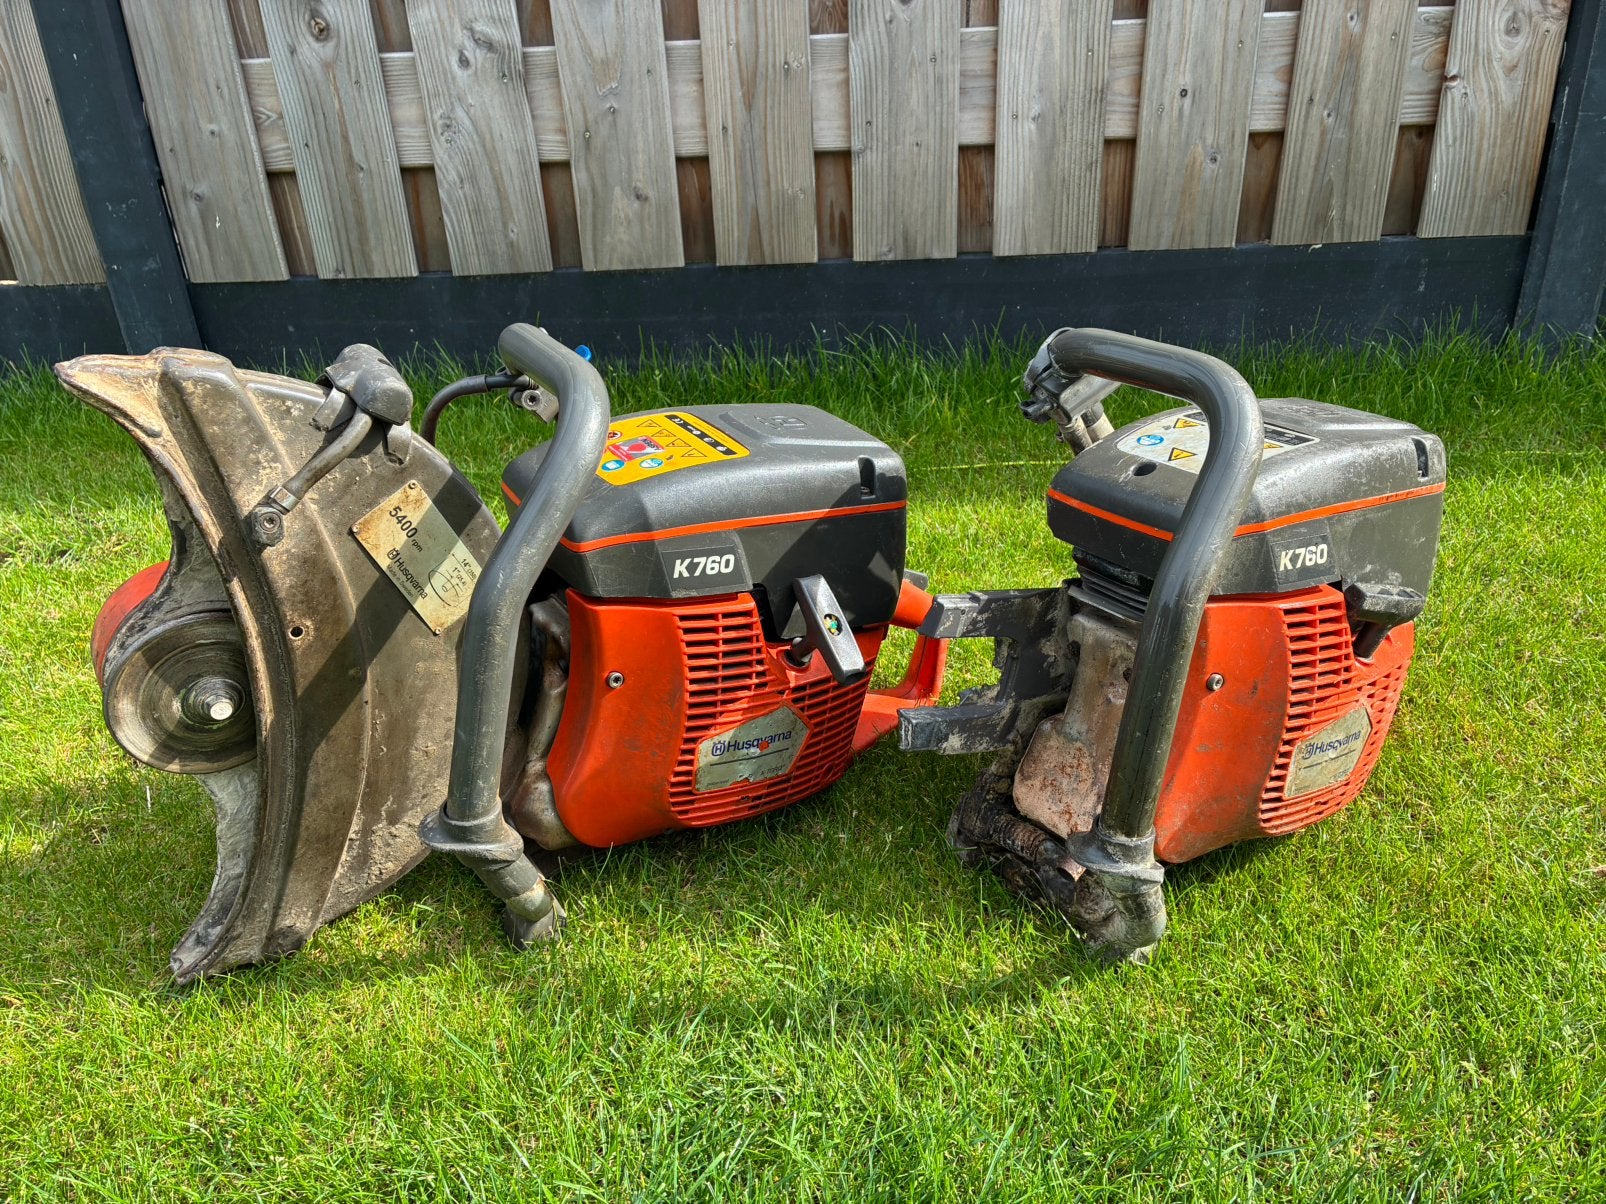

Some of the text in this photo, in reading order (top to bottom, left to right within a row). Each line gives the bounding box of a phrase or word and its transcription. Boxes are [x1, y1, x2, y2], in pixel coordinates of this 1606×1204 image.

[388, 505, 424, 553] 5400 rpm
[393, 558, 429, 601] Husqvarna
[1314, 730, 1362, 755] Husqvarna
